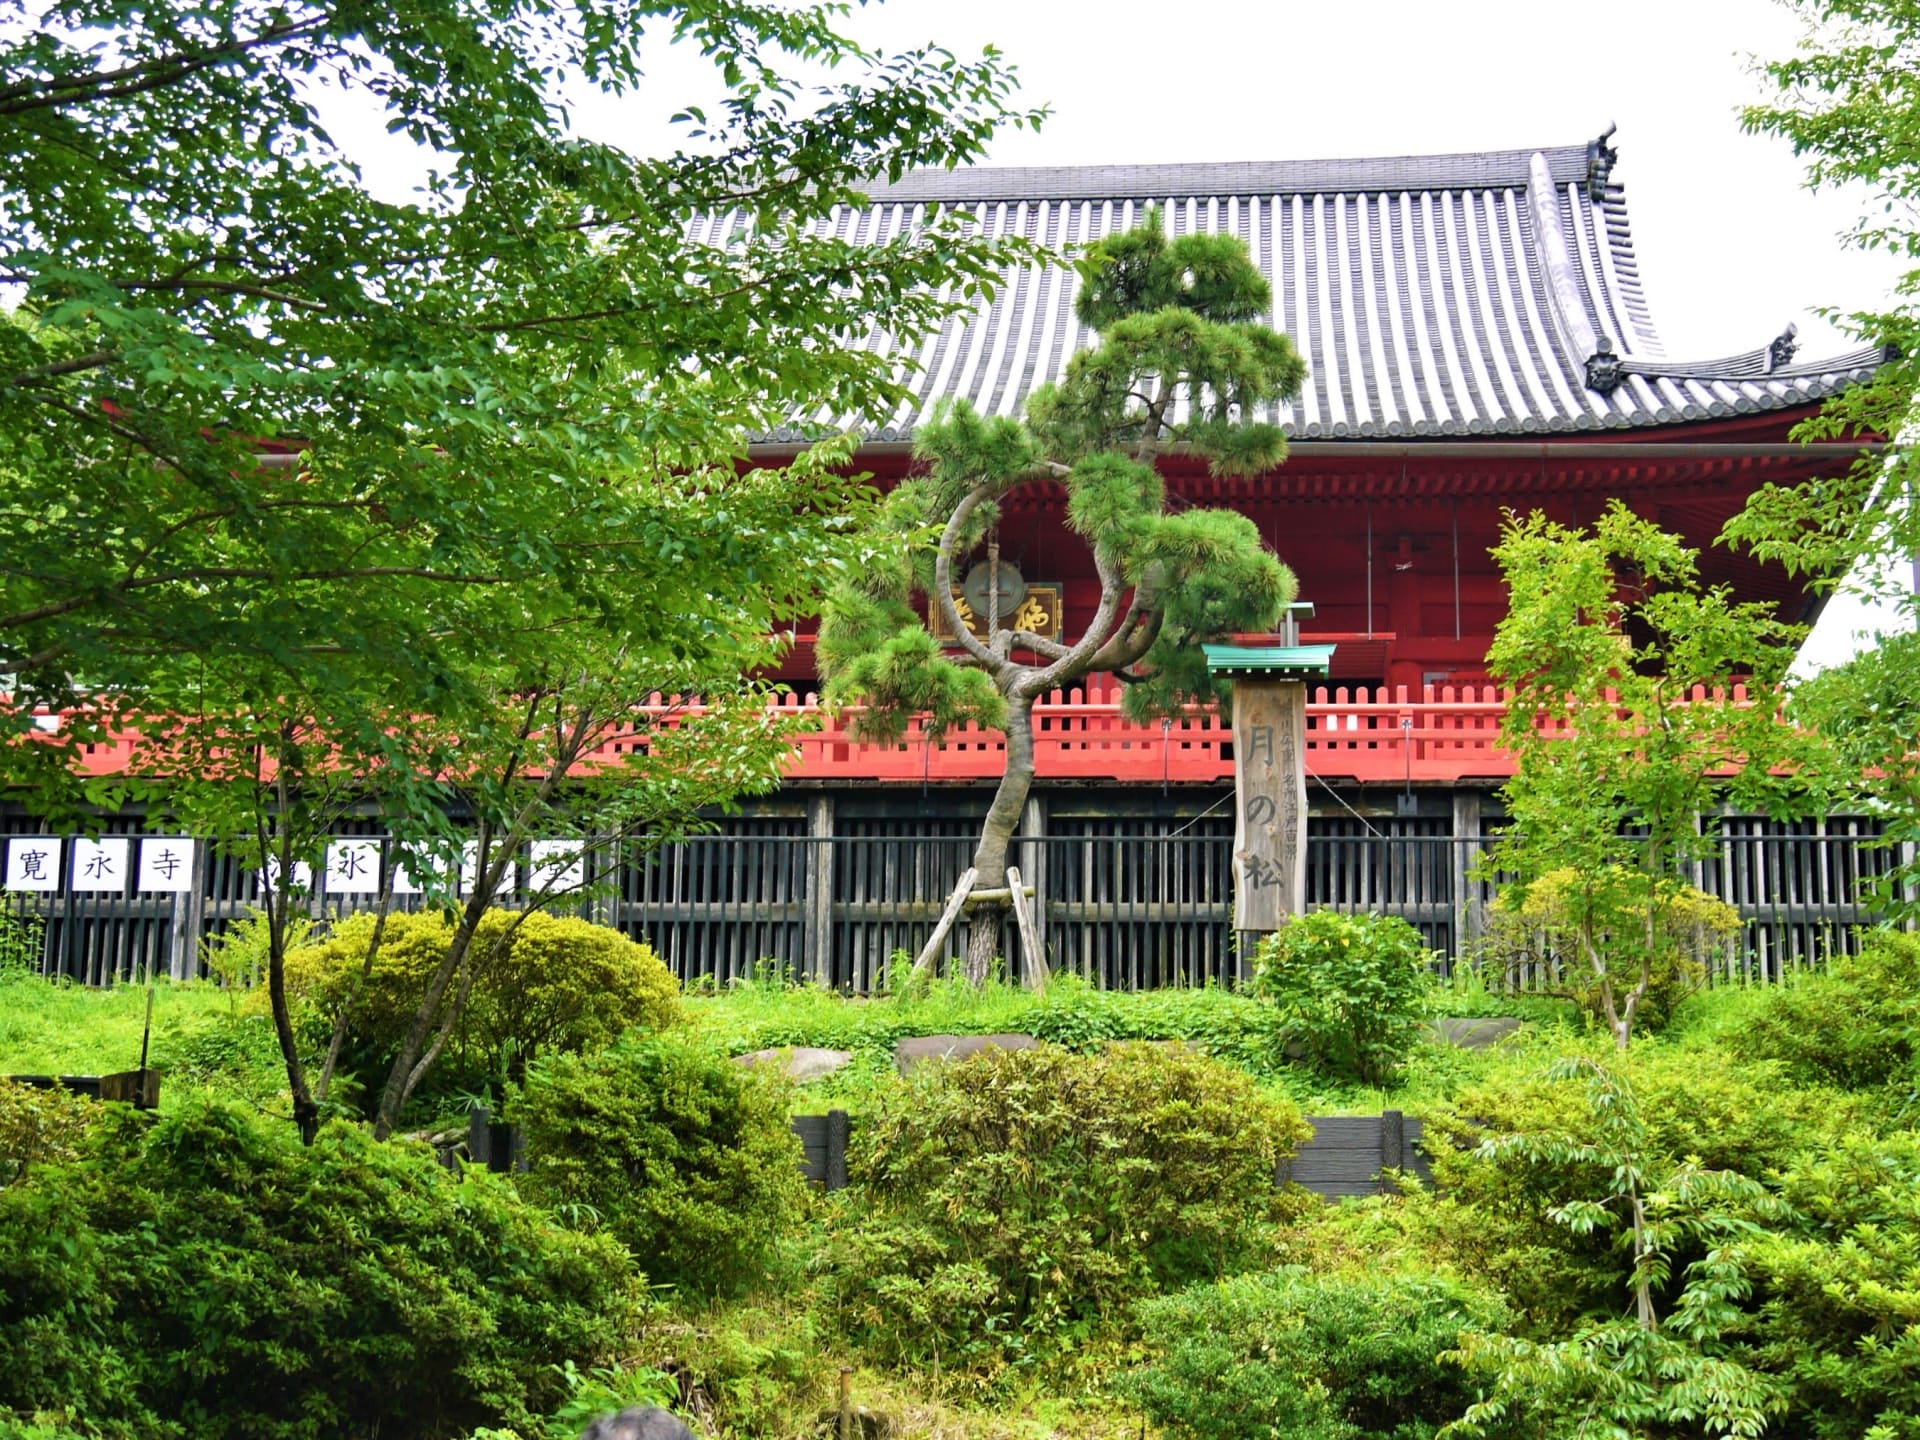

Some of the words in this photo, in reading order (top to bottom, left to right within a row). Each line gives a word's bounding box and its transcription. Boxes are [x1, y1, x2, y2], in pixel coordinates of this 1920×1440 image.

[1245, 724, 1284, 890] 月の松
[19, 848, 182, 881] 寛永寺
